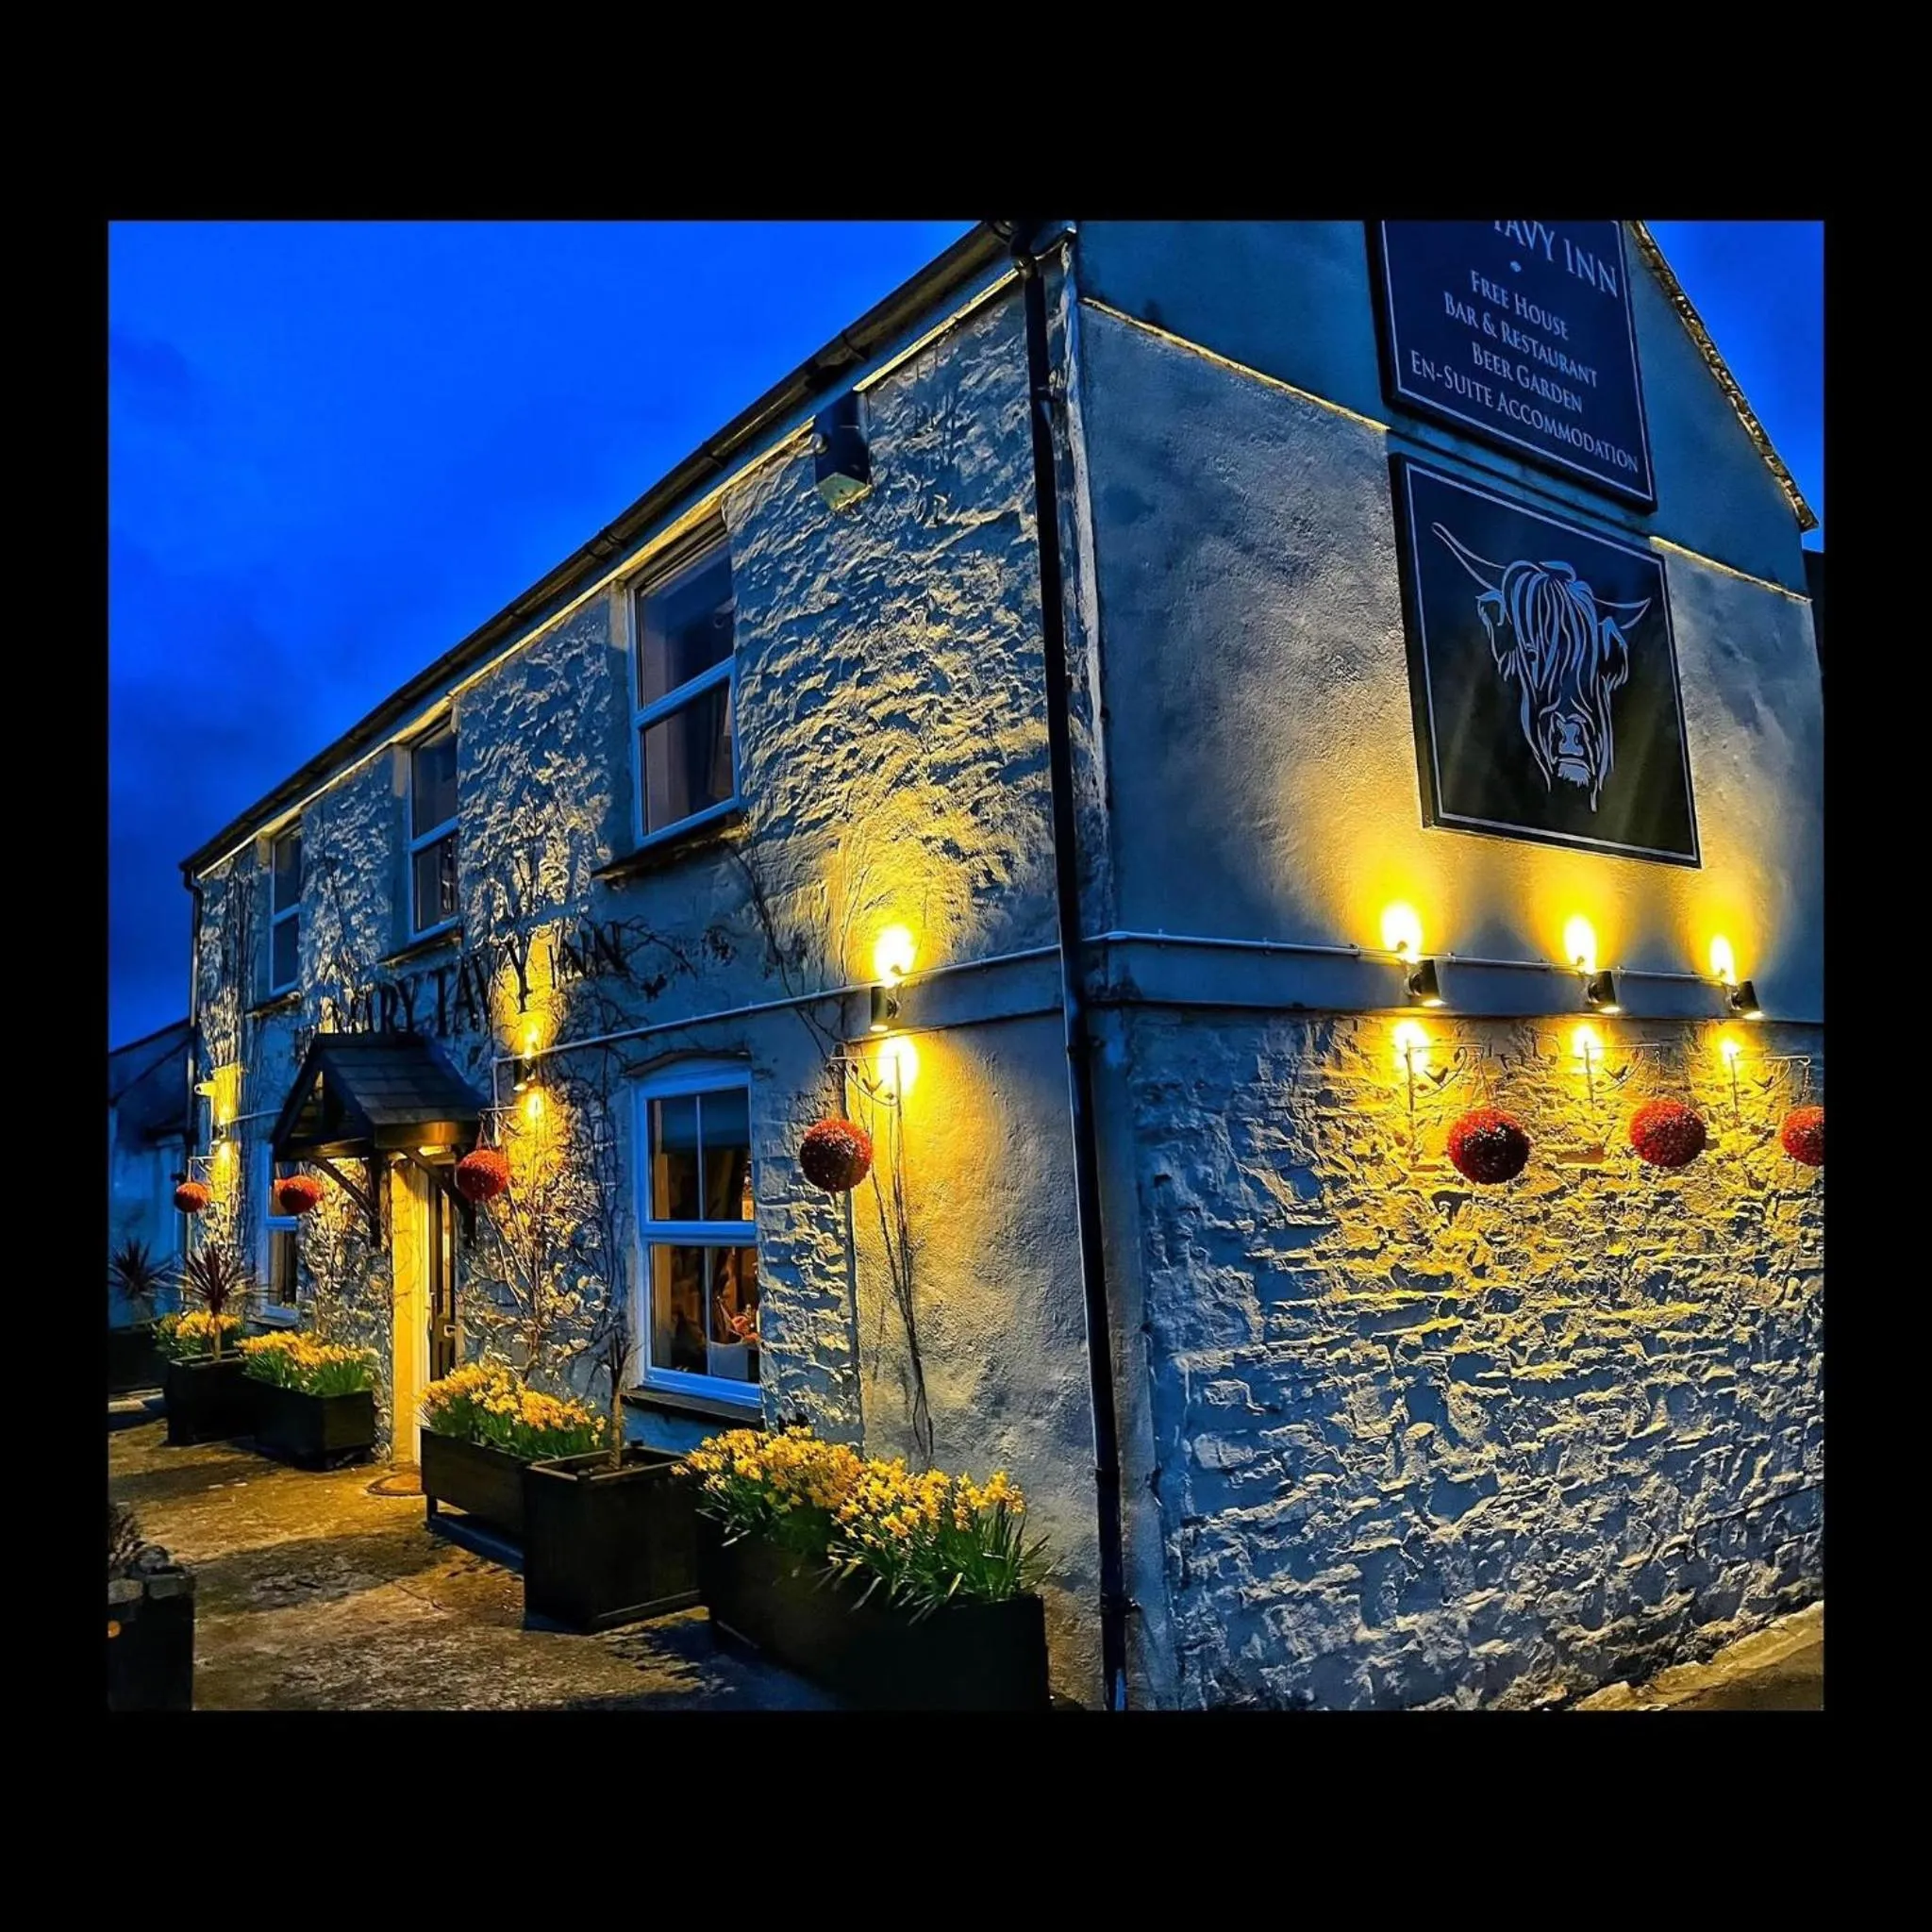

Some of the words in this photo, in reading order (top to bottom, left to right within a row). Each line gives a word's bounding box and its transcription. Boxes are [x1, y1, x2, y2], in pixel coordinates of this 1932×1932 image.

[1564, 239, 1619, 299] INN
[1444, 291, 1478, 328] BAR
[1482, 312, 1497, 339] &
[1502, 320, 1597, 388] RESTAURANT
[1471, 270, 1510, 310] FREE
[1514, 292, 1570, 341] HOUSE
[1410, 350, 1493, 408] EN-SUITE
[1496, 391, 1639, 473] ACCOMMODATION
[1472, 341, 1511, 379] BEER
[1517, 364, 1583, 413] GARDEN
